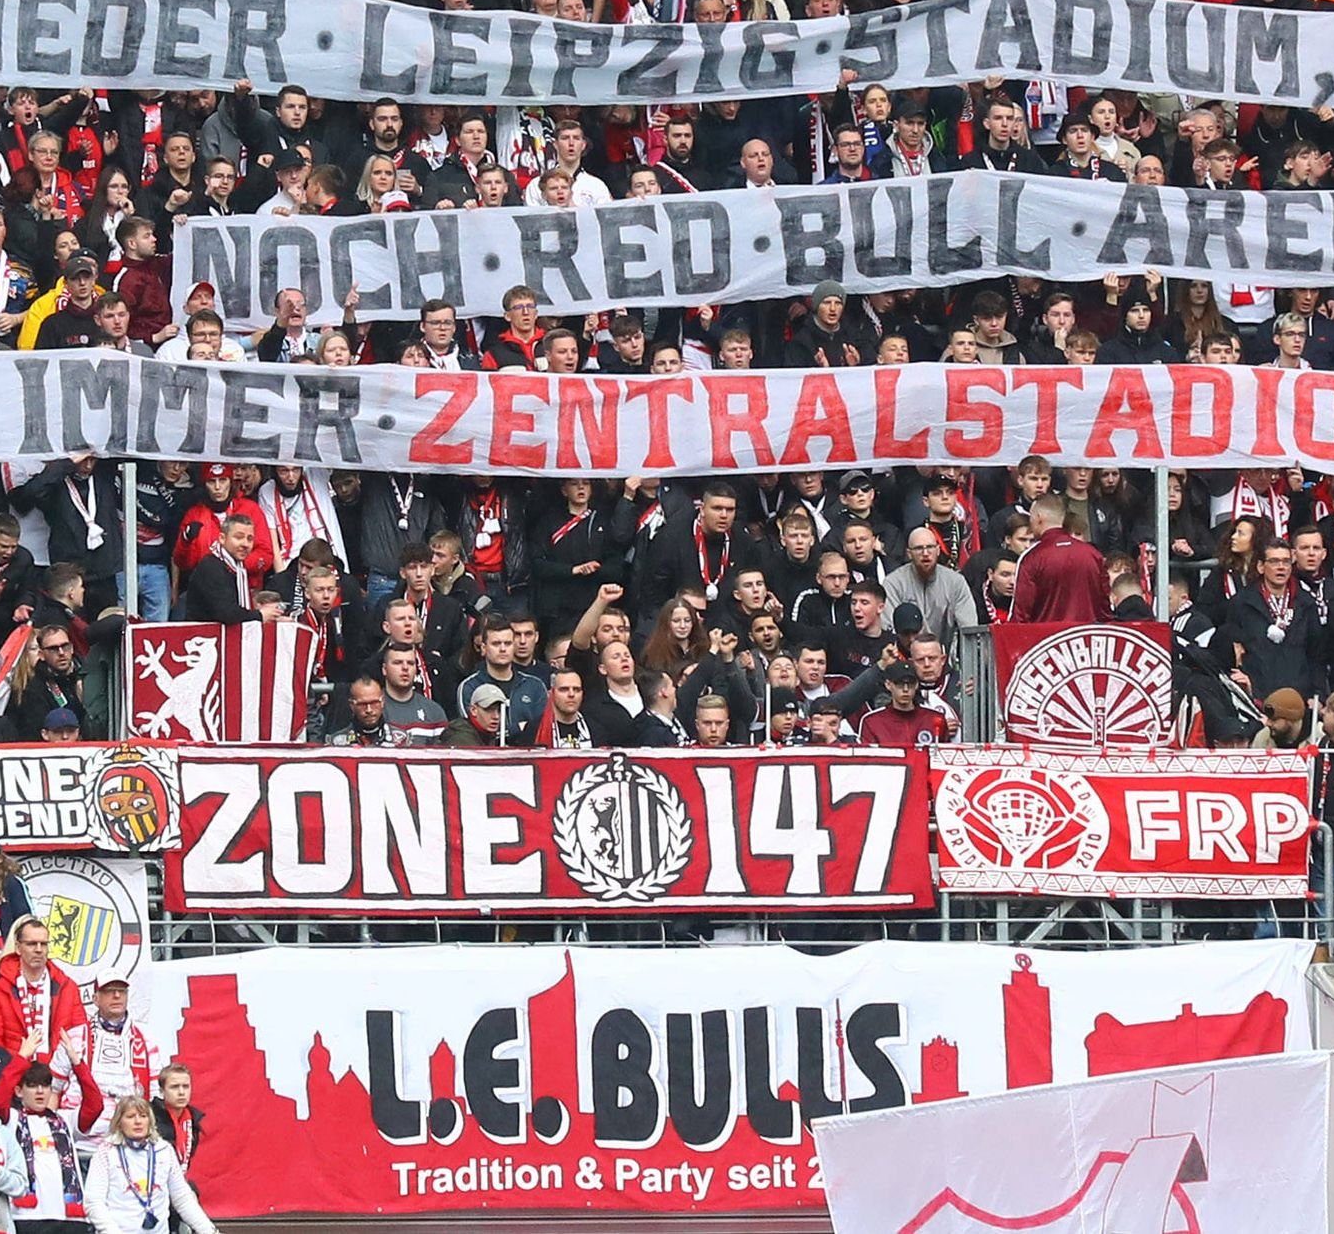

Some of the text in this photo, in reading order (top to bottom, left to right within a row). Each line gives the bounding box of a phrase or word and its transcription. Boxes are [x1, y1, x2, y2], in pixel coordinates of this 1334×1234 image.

[361, 2, 799, 97] LEIPZIG
[192, 212, 465, 322] NOCH
[519, 200, 732, 311] RED
[778, 180, 1051, 286] BULL
[13, 357, 363, 464] IMMER
[182, 759, 907, 896] ZONE 147
[1125, 790, 1310, 865] FRP
[367, 1002, 909, 1152] L.E. BULLS
[392, 1156, 563, 1197] Tradition
[575, 1155, 606, 1190] &
[615, 1154, 713, 1202] Party
[728, 1154, 796, 1191] seit
